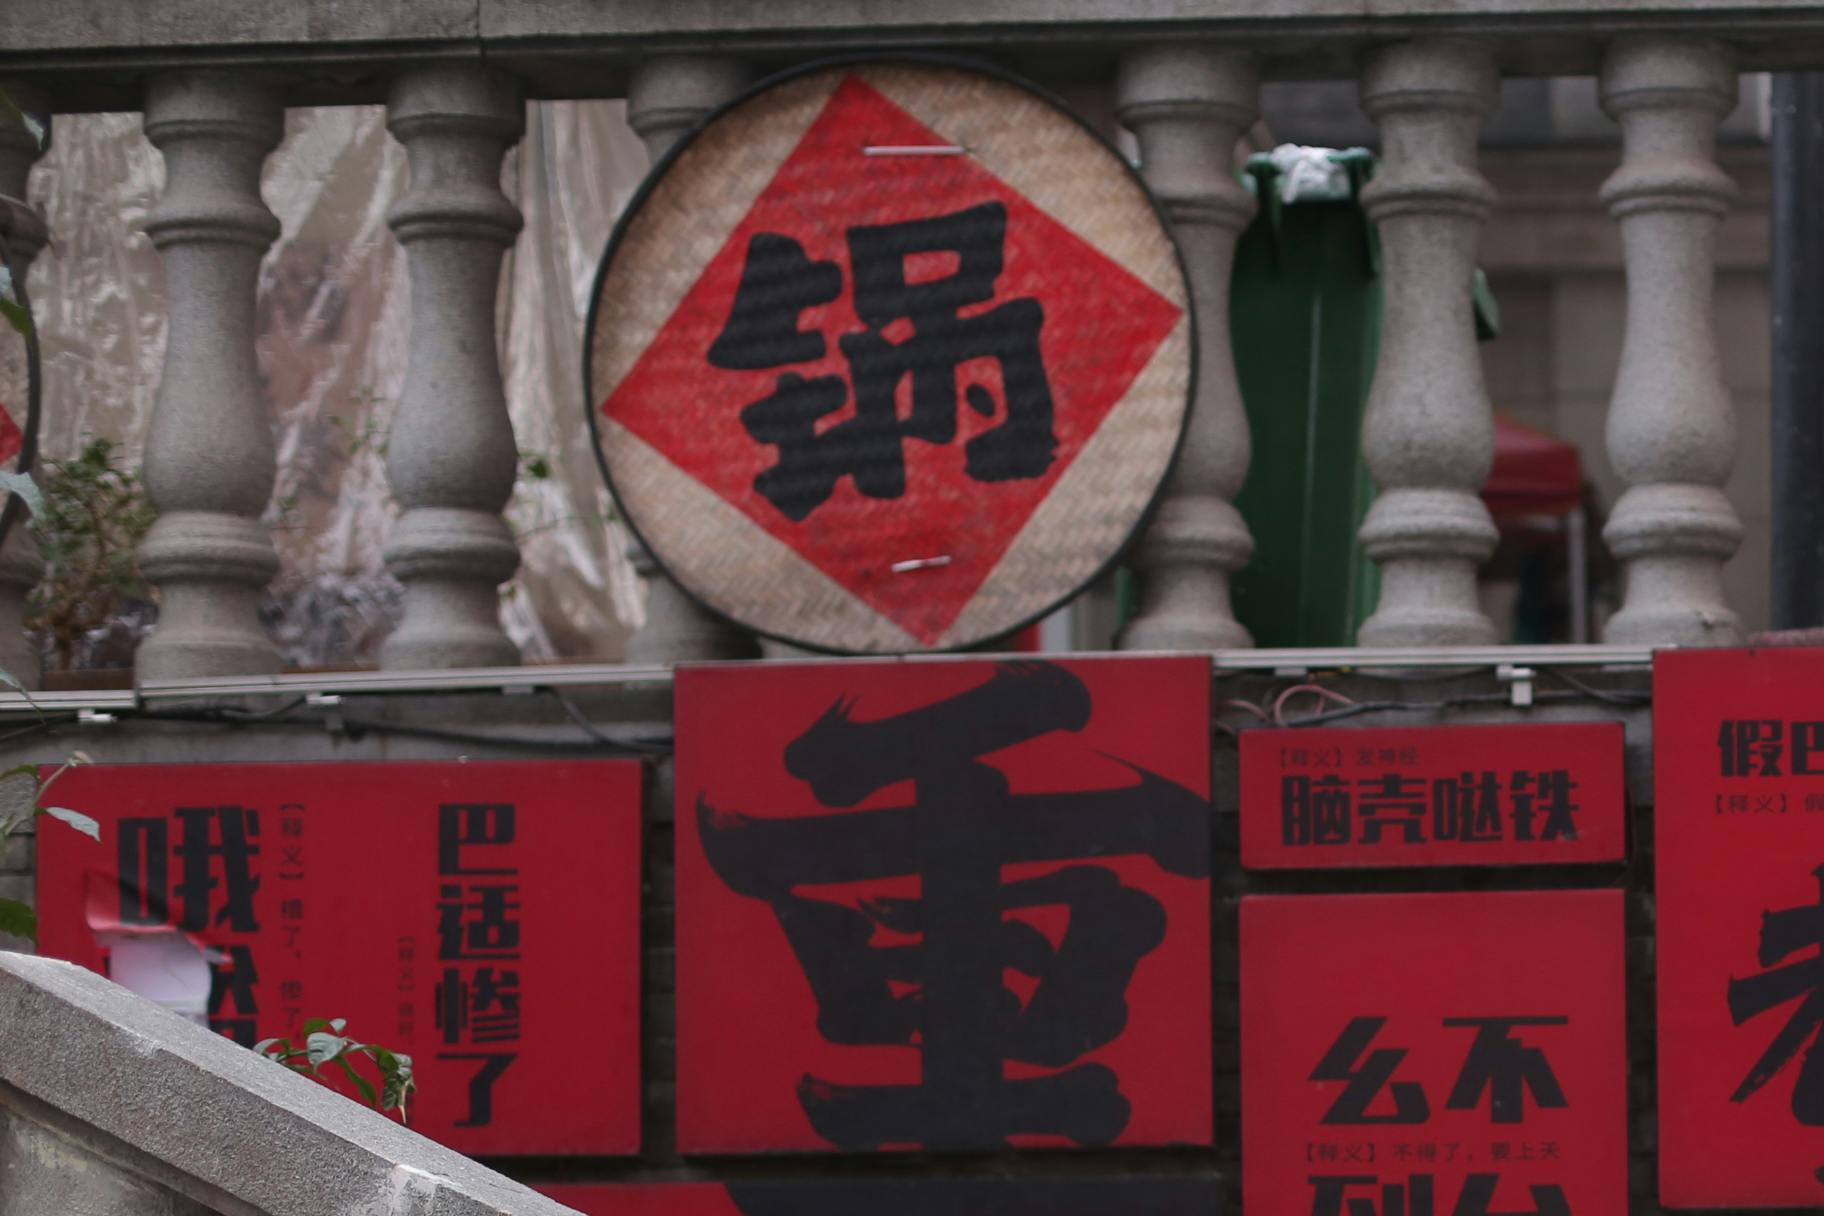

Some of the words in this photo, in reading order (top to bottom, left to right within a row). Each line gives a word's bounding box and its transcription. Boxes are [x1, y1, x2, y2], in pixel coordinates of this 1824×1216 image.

[706, 200, 1060, 523] 锅
[435, 803, 521, 1128] 巴适惨了
[696, 659, 1212, 1150] 重
[1281, 769, 1580, 846] 脑壳哒铁
